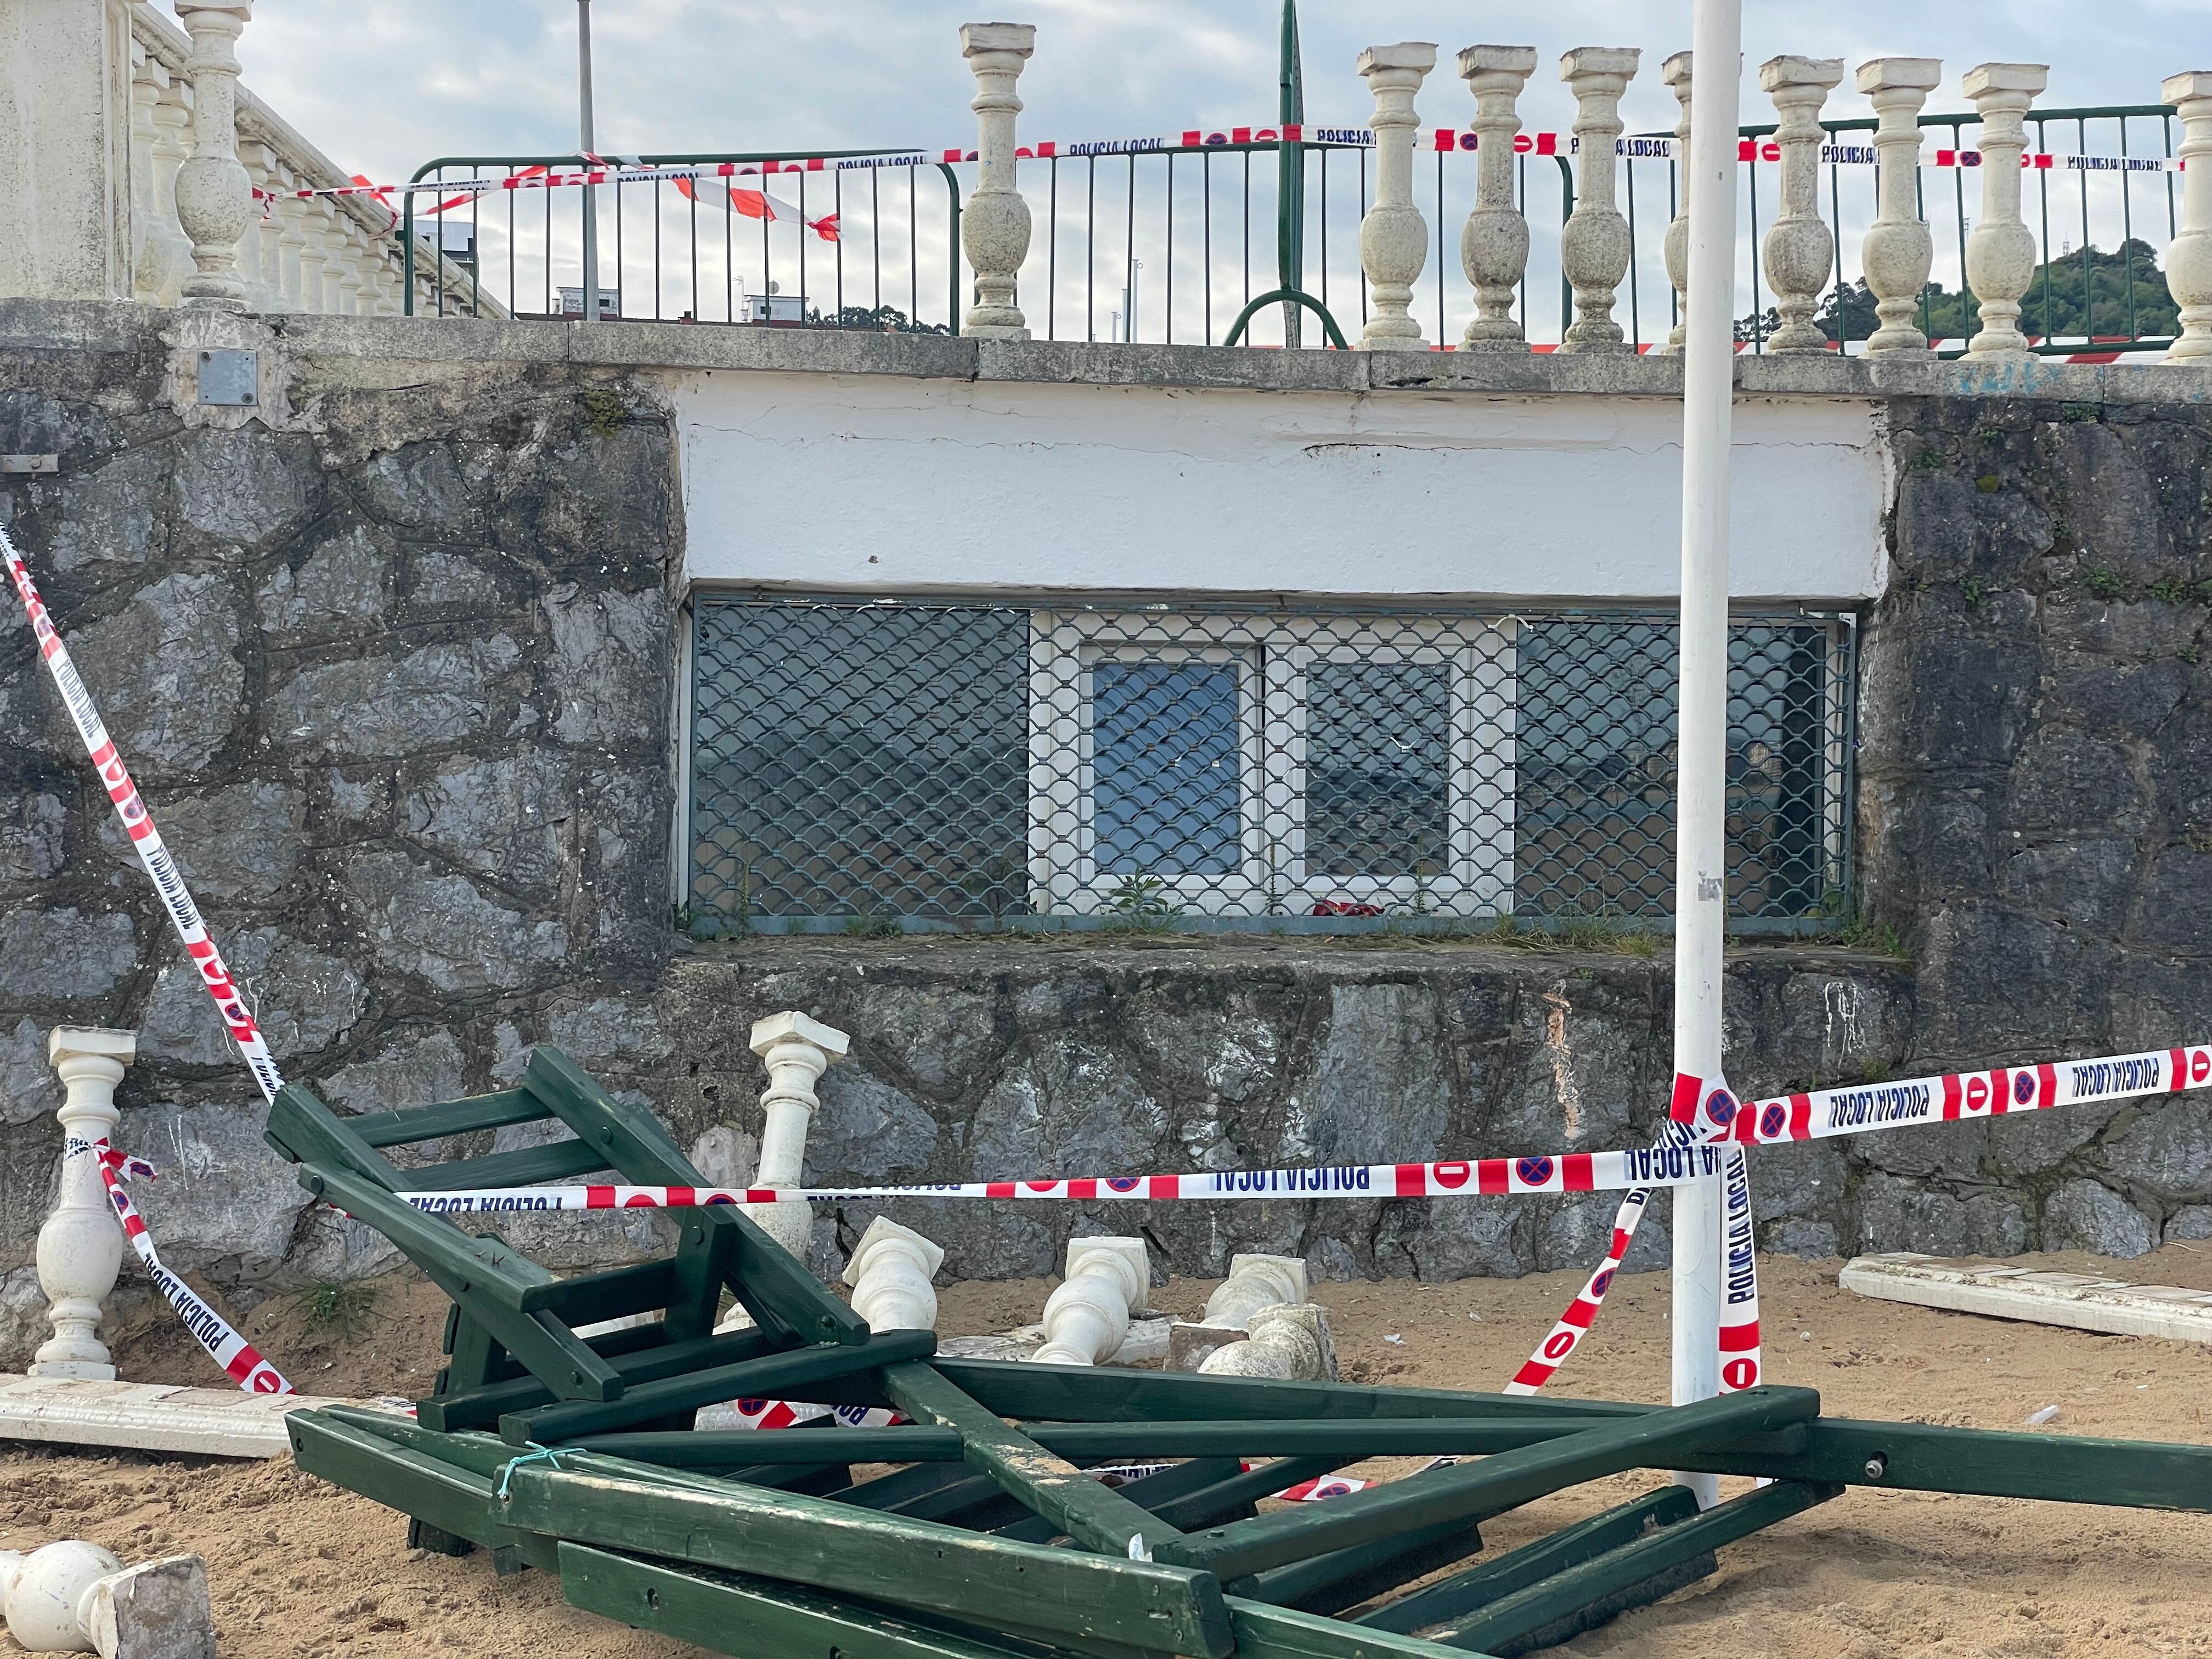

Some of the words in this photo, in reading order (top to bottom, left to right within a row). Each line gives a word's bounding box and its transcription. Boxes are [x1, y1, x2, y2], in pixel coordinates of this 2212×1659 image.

[1070, 141, 1118, 155] POLICIA
[1317, 129, 1369, 144] POLICIA
[1628, 139, 1670, 157] LOCAL
[1822, 145, 1874, 164] POLICIA
[2067, 156, 2118, 170] POLICIA
[2122, 159, 2162, 171] LOCAL
[56, 658, 86, 707] POLICIA
[76, 696, 101, 738] LOCAL
[146, 843, 182, 894] POLICIA
[169, 889, 199, 929] LOCAL
[2072, 1064, 2111, 1097] LOCAL
[2113, 1058, 2159, 1092] POLICIA
[1830, 1091, 1874, 1127] LOCAL
[1877, 1085, 1930, 1121] POLICIA
[1286, 1166, 1369, 1190] POLICIA
[1625, 1146, 1695, 1180] LOCAL
[1726, 1150, 1749, 1221] LOCAL
[145, 1252, 180, 1300] LOCAL
[1728, 1220, 1754, 1304] POLICIA
[174, 1291, 230, 1352] POLICIA
